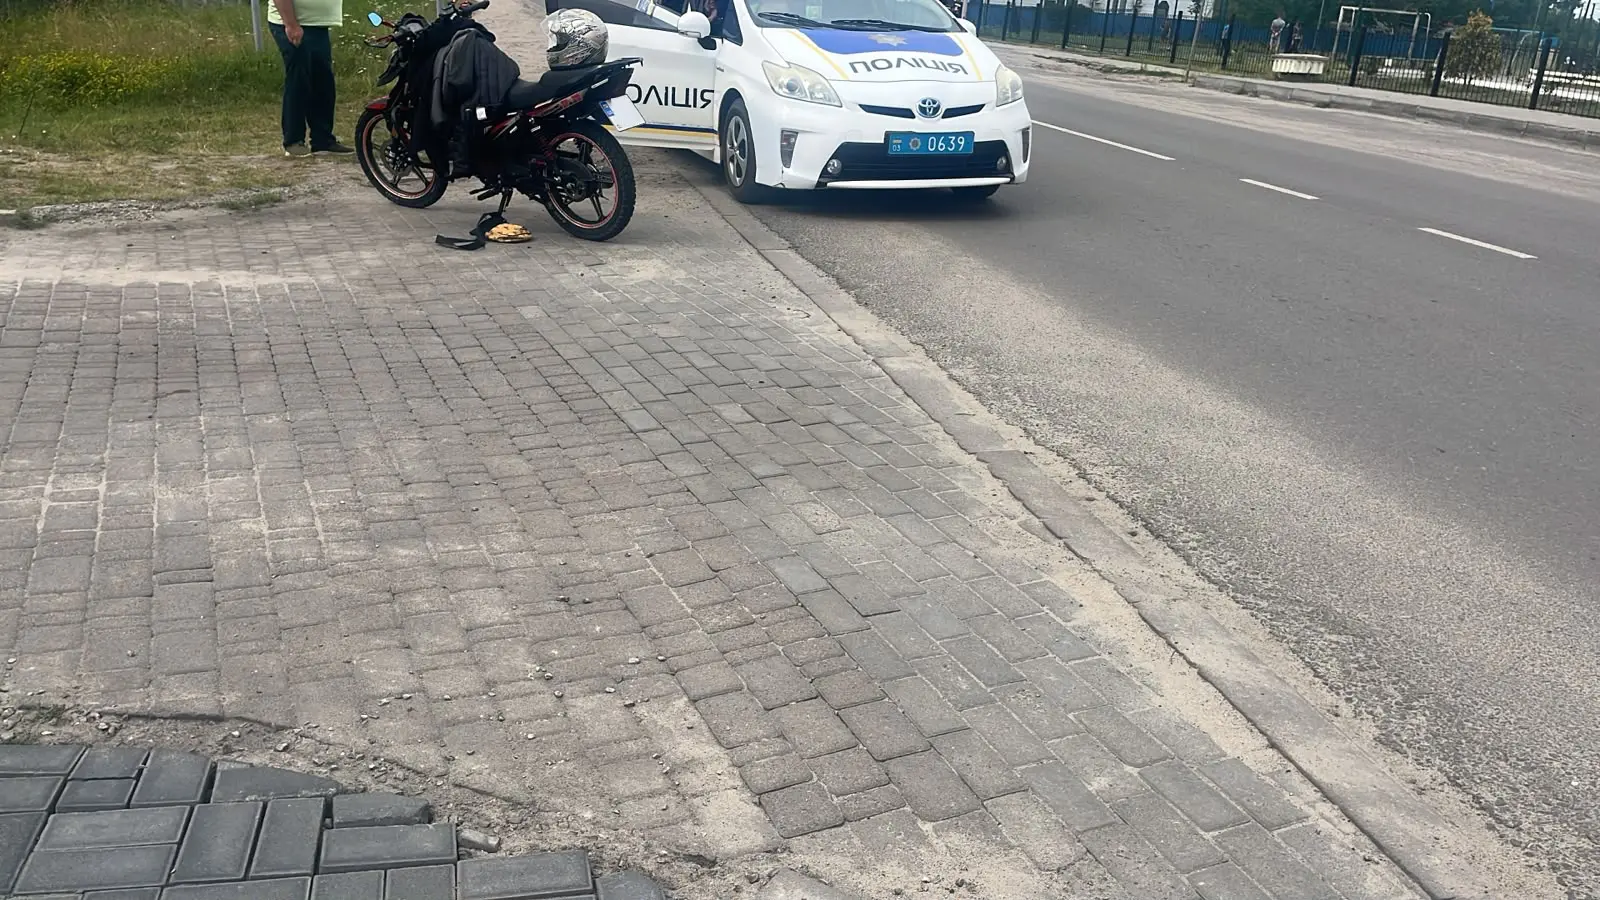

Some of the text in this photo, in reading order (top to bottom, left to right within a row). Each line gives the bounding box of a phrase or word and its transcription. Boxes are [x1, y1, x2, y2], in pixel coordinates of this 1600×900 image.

[849, 57, 968, 75] ПОЛІЦІЯ
[625, 83, 714, 109] ОЛІЦІЯ
[892, 136, 965, 152] 03 0639
